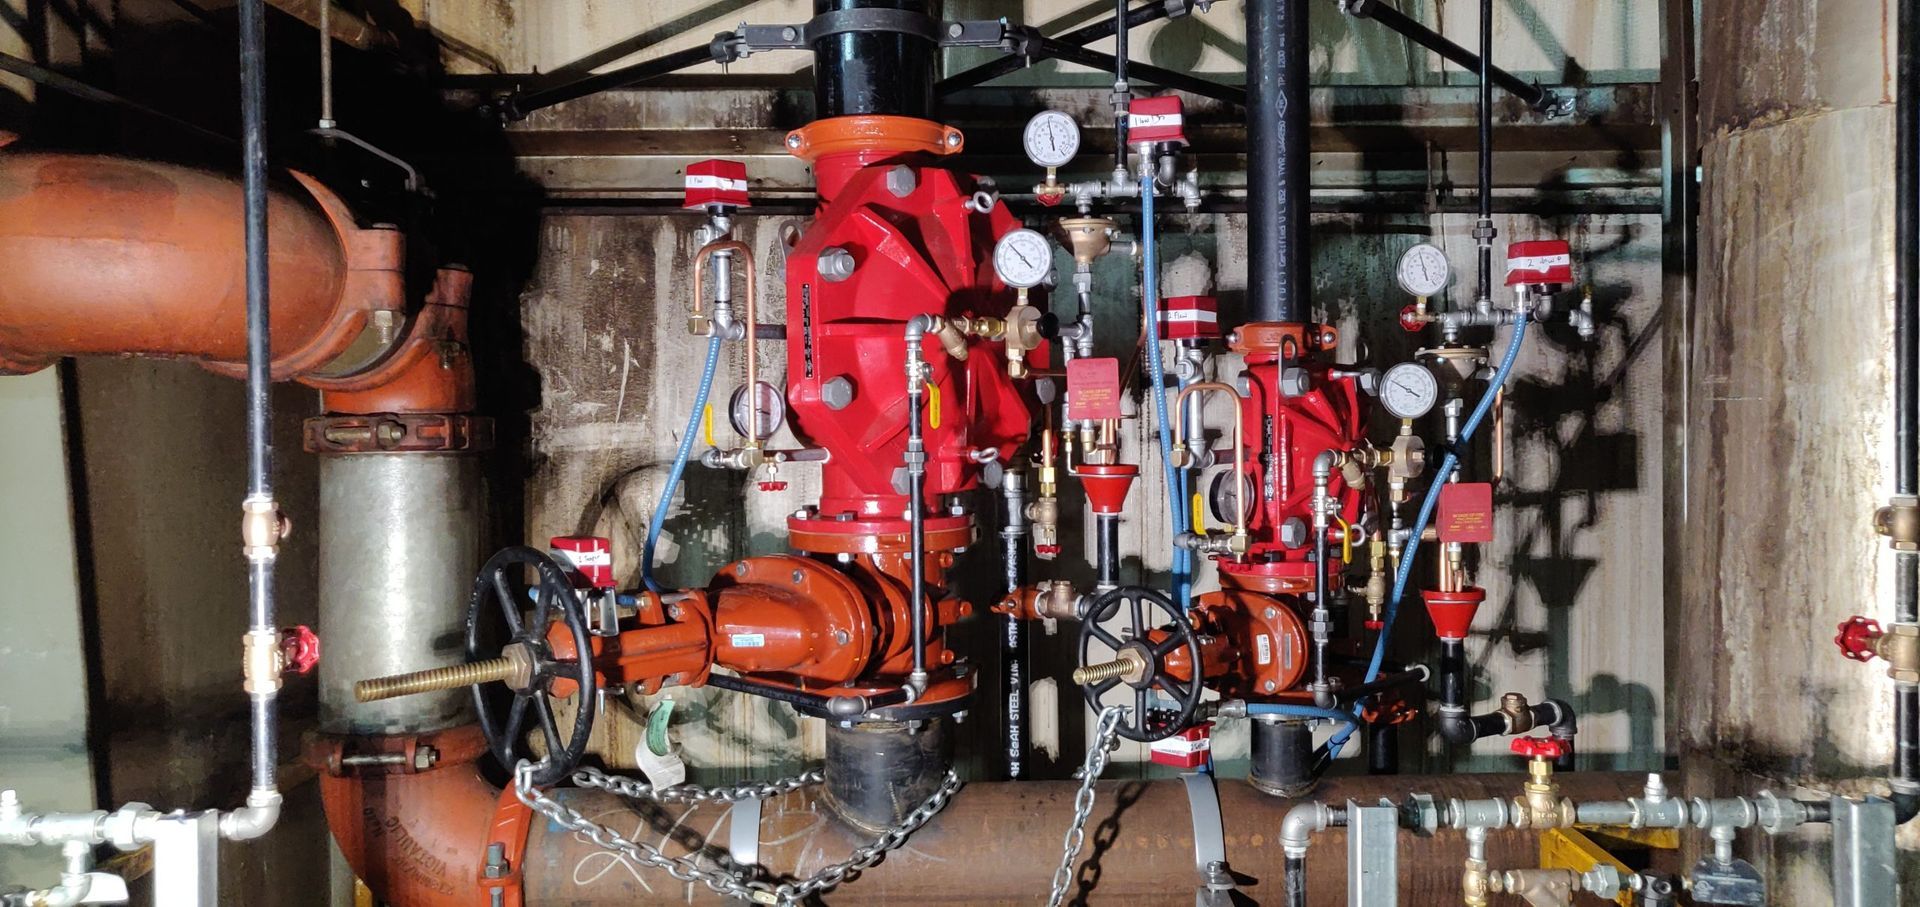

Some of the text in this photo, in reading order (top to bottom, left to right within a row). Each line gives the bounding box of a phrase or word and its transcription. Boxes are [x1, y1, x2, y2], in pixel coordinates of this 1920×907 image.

[1008, 622, 1018, 648] ASTM
[1009, 689, 1020, 721] STEEL
[385, 815, 447, 879] VICTAULIC
